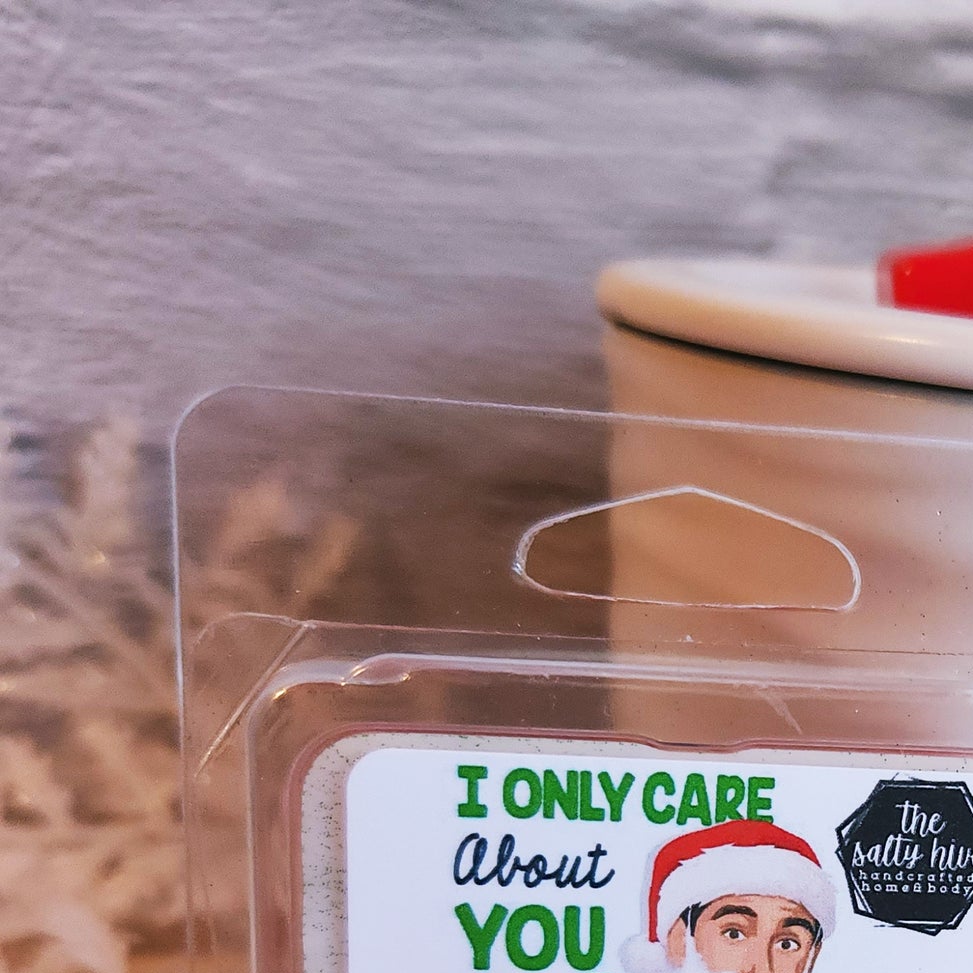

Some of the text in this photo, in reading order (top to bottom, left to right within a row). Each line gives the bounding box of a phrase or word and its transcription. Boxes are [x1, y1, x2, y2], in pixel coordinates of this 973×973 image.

[458, 765, 775, 825] I ONLY CARE
[895, 800, 946, 837] the
[851, 833, 924, 869] salty
[455, 902, 604, 972] YOU
